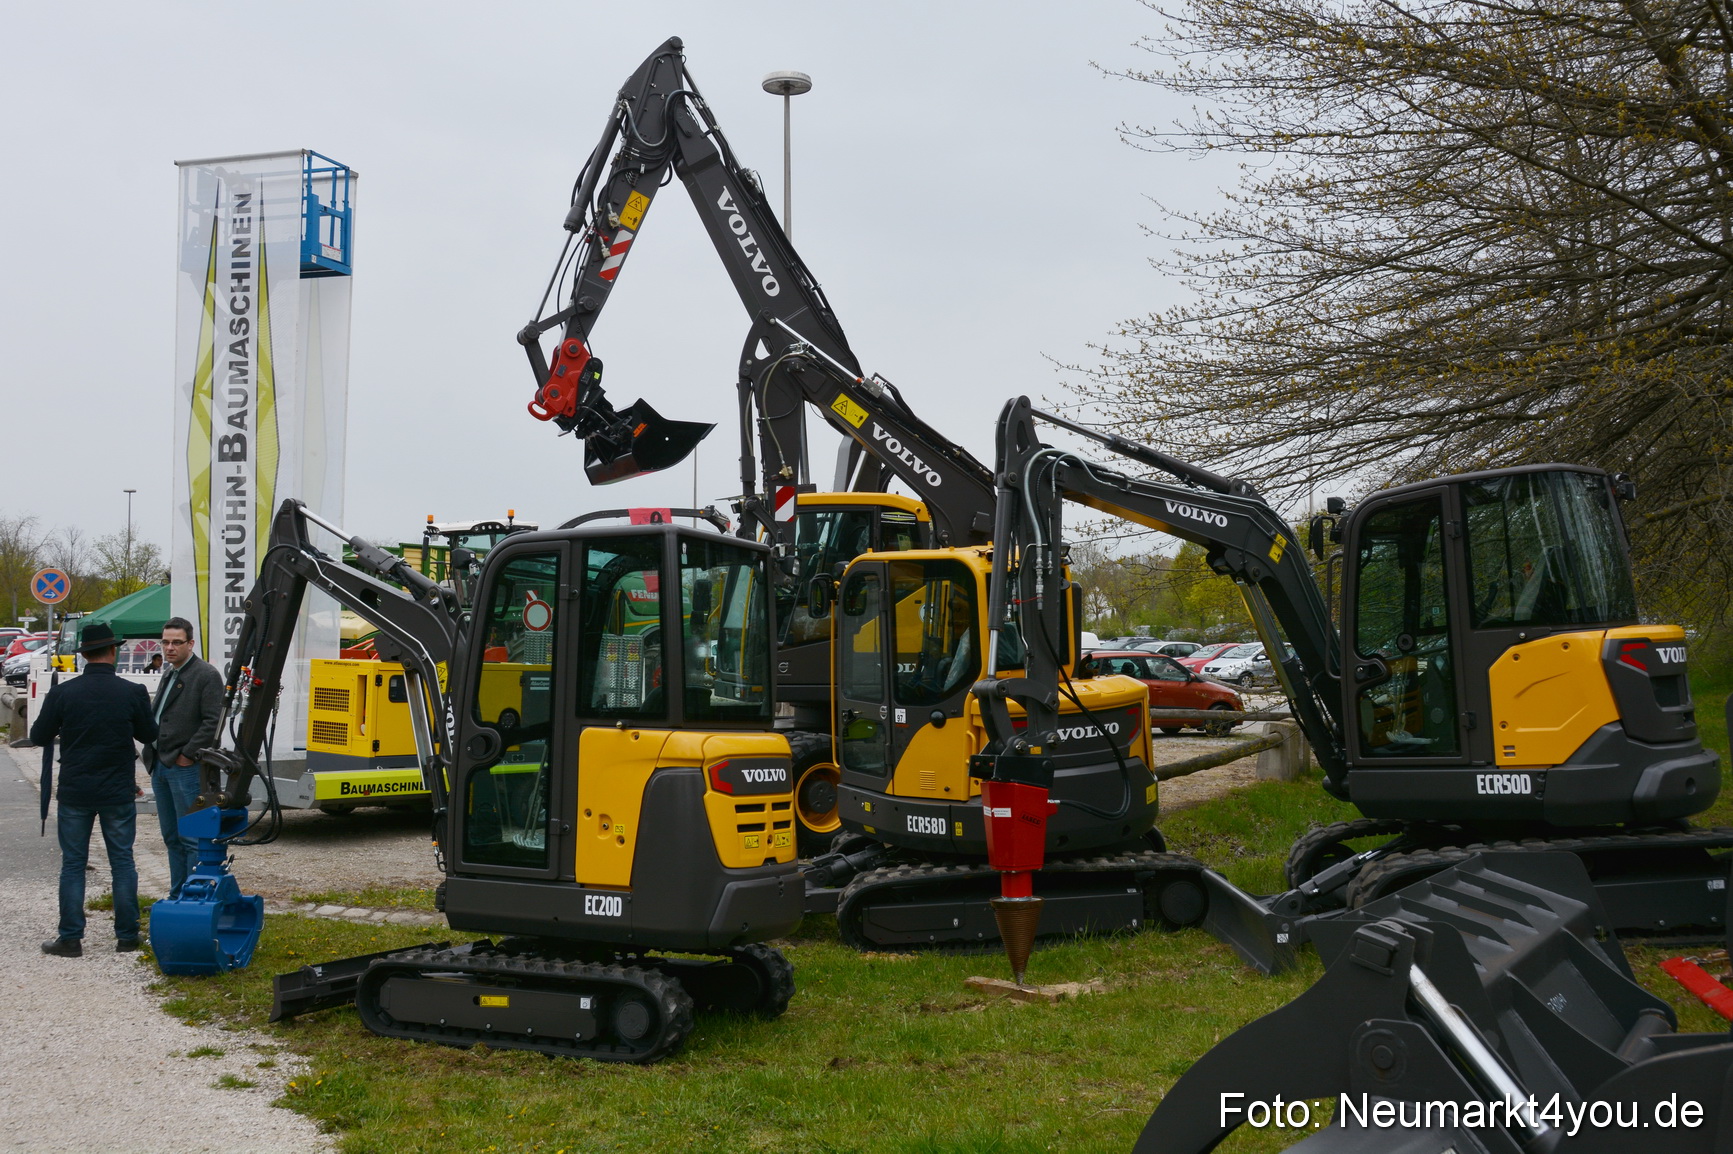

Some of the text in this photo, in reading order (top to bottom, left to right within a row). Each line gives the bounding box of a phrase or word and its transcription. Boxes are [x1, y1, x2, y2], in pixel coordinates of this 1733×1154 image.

[717, 185, 780, 297] VOLVO
[218, 193, 252, 717] HSENKÜHN-BAUMASCHINEN
[872, 421, 942, 487] VOLVO
[1165, 499, 1228, 528] VOLVO
[631, 589, 659, 600] FEND
[1655, 647, 1687, 664] VOL
[741, 768, 786, 782] VOLVO
[1476, 774, 1532, 795] ECR50D
[340, 781, 426, 795] BAUMASCHINE
[907, 814, 947, 835] ECR58D
[585, 894, 622, 916] EC20D
